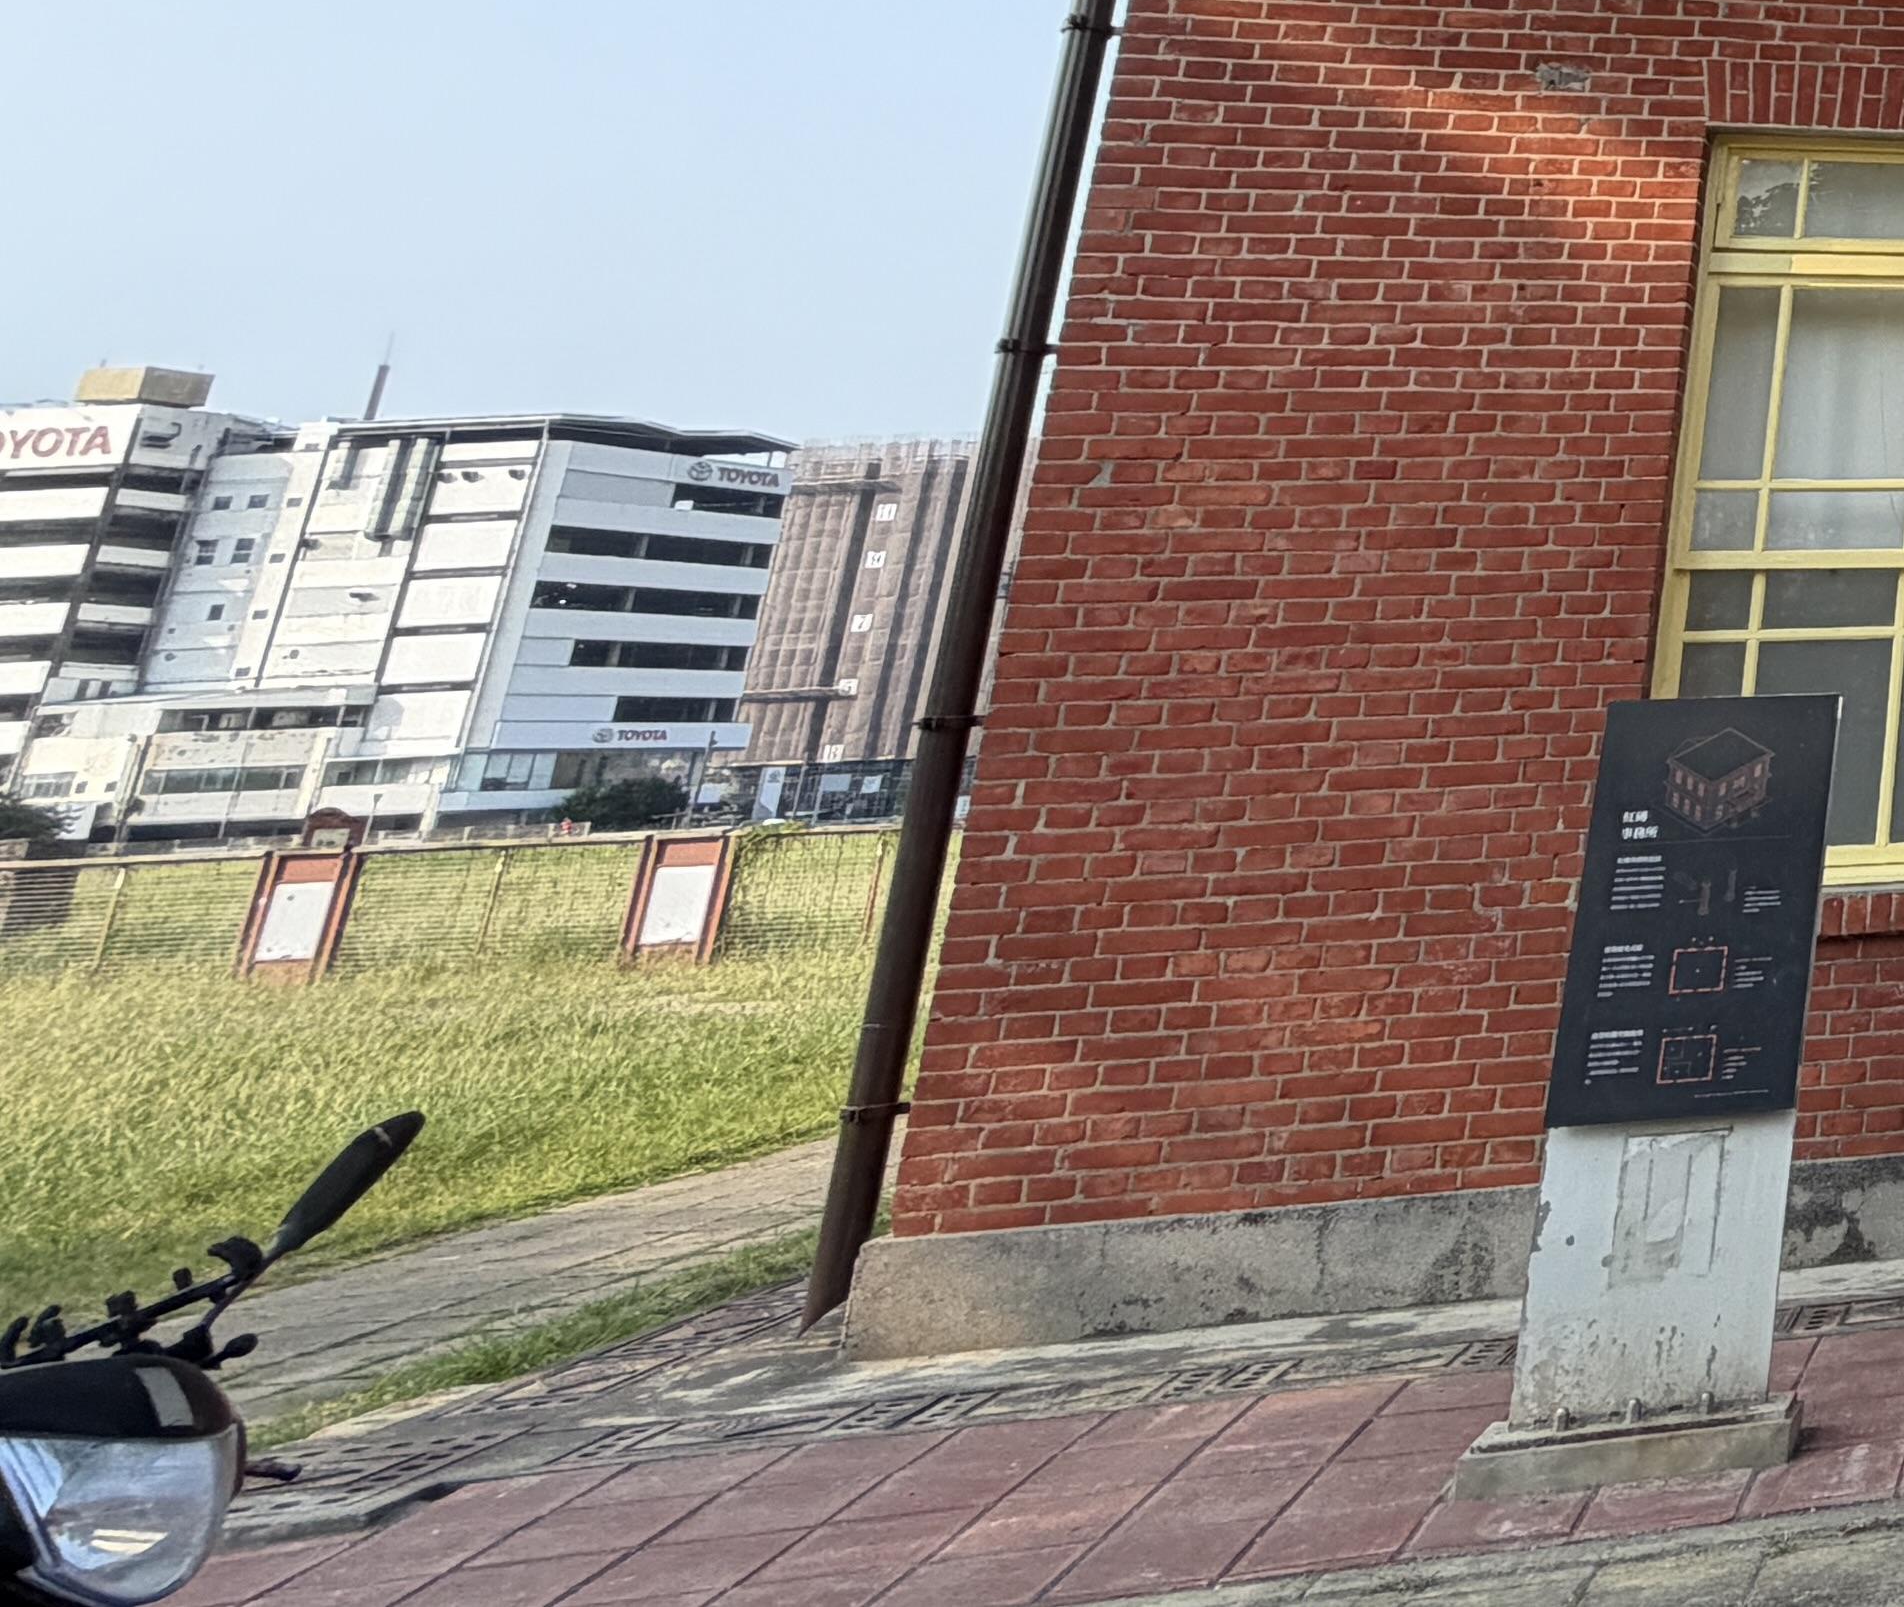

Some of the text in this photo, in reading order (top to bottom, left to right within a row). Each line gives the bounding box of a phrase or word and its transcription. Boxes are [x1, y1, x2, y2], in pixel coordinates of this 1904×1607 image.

[0, 427, 112, 459] YOTA
[717, 466, 779, 488] TOYOTA
[616, 729, 668, 742] TOYOTA
